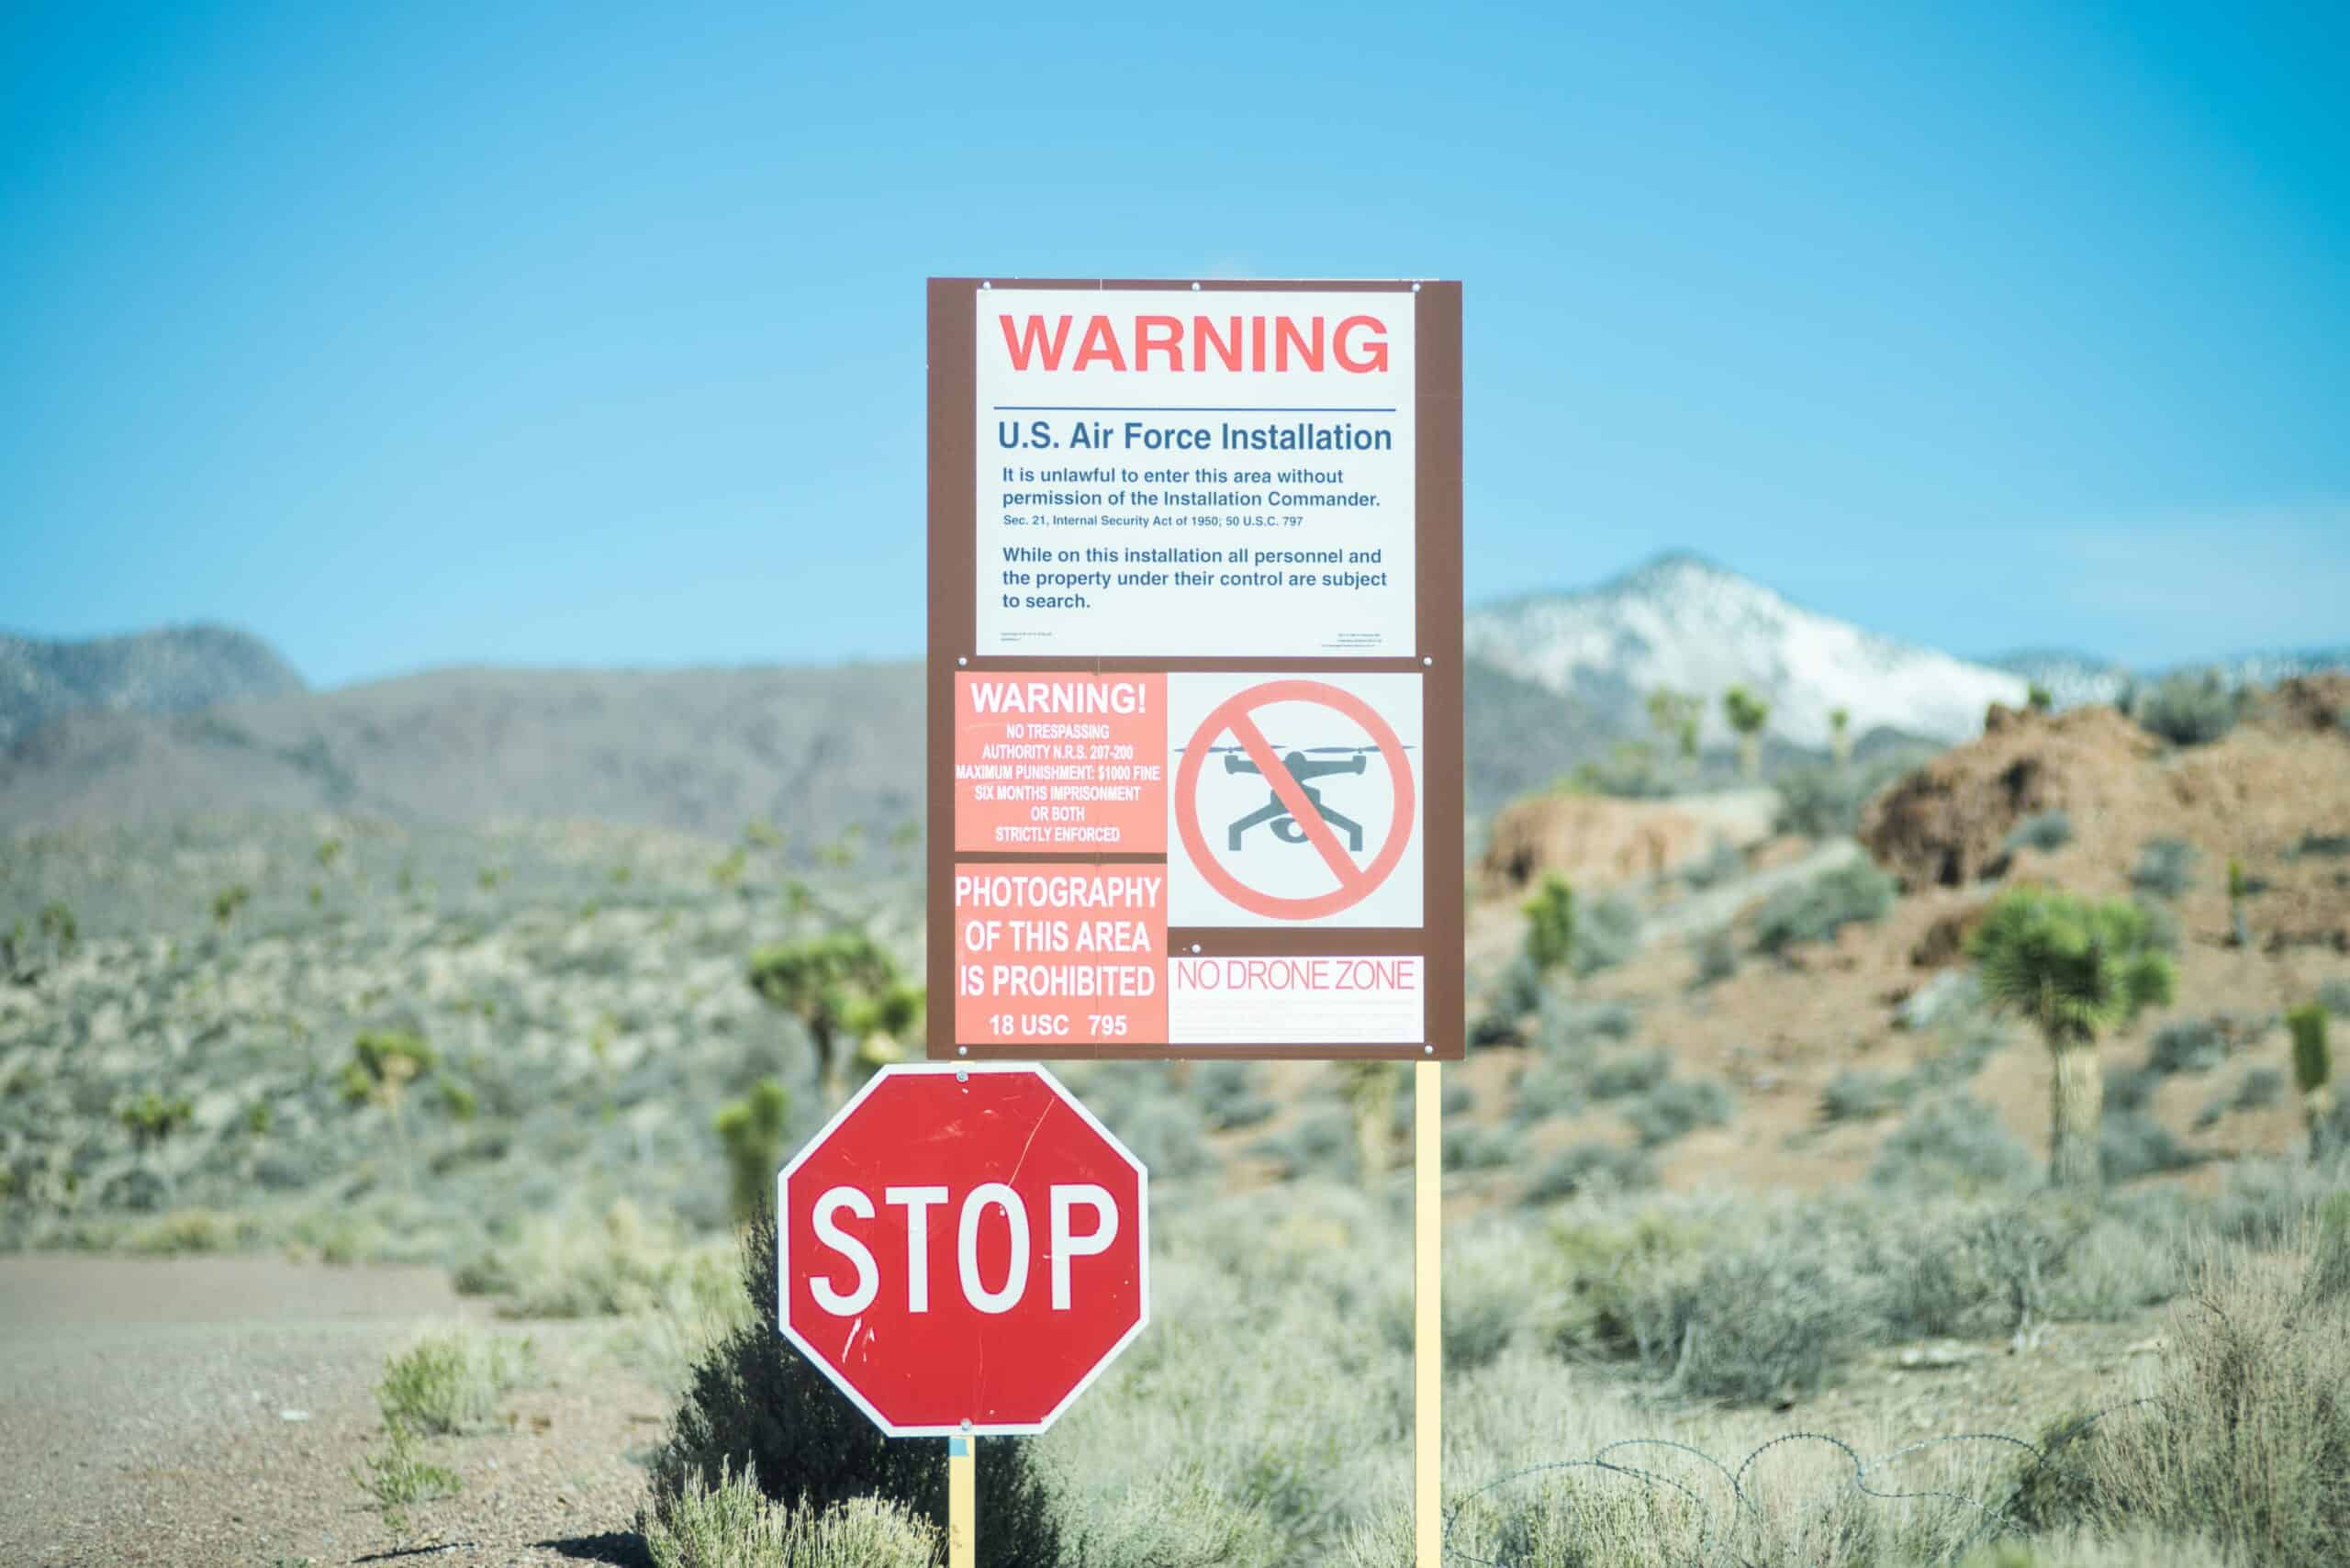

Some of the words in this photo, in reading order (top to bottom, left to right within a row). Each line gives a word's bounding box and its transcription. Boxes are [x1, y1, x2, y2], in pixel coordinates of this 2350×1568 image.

[998, 314, 1389, 375] WARNING
[999, 420, 1059, 449] U.S.
[1069, 421, 1114, 449] Air
[1125, 421, 1212, 450] Force
[1222, 422, 1392, 451] Installation
[1002, 466, 1014, 483] It
[1020, 466, 1035, 483] is
[1040, 466, 1115, 483] unlawful
[1121, 468, 1139, 483] to
[1144, 468, 1191, 484] enter
[1194, 467, 1228, 484] this
[1233, 471, 1271, 484] area
[1277, 468, 1344, 484] without
[1002, 489, 1102, 510] permission
[1107, 490, 1125, 506] of
[1130, 490, 1158, 506] the
[1164, 491, 1262, 507] Installation
[1268, 490, 1381, 507] Commander.
[1002, 514, 1029, 526] Sec.
[1032, 514, 1050, 526] 21,
[1052, 514, 1098, 526] Internal
[1101, 514, 1150, 529] Security
[1152, 515, 1172, 527] Act
[1175, 515, 1188, 526] of
[1192, 515, 1222, 528] 1950;
[1225, 515, 1240, 527] 50
[1242, 515, 1279, 527] U.S.C.
[1281, 516, 1304, 527] 797
[1002, 546, 1053, 563] While
[1058, 550, 1080, 563] on
[1086, 547, 1119, 563] this
[1125, 547, 1223, 564] installation
[1227, 547, 1248, 564] all
[1254, 548, 1343, 567] personnel
[1348, 548, 1382, 564] and
[1002, 569, 1031, 586] the
[1035, 570, 1112, 590] property
[1117, 570, 1169, 587] under
[1174, 570, 1215, 587] their
[1219, 571, 1283, 587] control
[1288, 574, 1316, 587] are
[1321, 571, 1387, 590] subject
[1002, 593, 1021, 609] to
[1025, 593, 1091, 609] search.
[970, 682, 1146, 714] WARNING!
[1006, 723, 1024, 739] NO
[1027, 723, 1110, 740] TRESPASSING
[981, 744, 1051, 759] AUTHORITY
[1053, 744, 1088, 760] N.R.S.
[1090, 744, 1134, 760] 207-200
[956, 764, 1013, 780] MAXIMUM
[1015, 764, 1095, 780] PUNISHMENT:
[1097, 765, 1131, 781] $1000
[1133, 765, 1161, 781] FINE
[974, 785, 994, 801] SIX
[996, 785, 1047, 801] MONTHS
[1050, 785, 1142, 801] IMPRISONMENT
[1030, 805, 1049, 822] OR
[1051, 805, 1085, 822] BOTH
[995, 825, 1052, 842] STRICTLY
[1054, 826, 1121, 843] ENFORCED
[956, 876, 1161, 908] PHOTOGRAPHY
[965, 920, 1002, 952] OF
[1008, 920, 1069, 952] THIS
[1075, 921, 1151, 952] AREA
[960, 965, 985, 996] IS
[992, 965, 1156, 997] PROHIBITED
[1178, 959, 1221, 991] NO
[1226, 959, 1330, 991] DRONE
[1335, 959, 1416, 991] ZONE
[990, 1014, 1014, 1036] 18
[1021, 1014, 1069, 1036] USC
[1088, 1014, 1127, 1036] 795
[809, 1182, 1119, 1316] STOP
